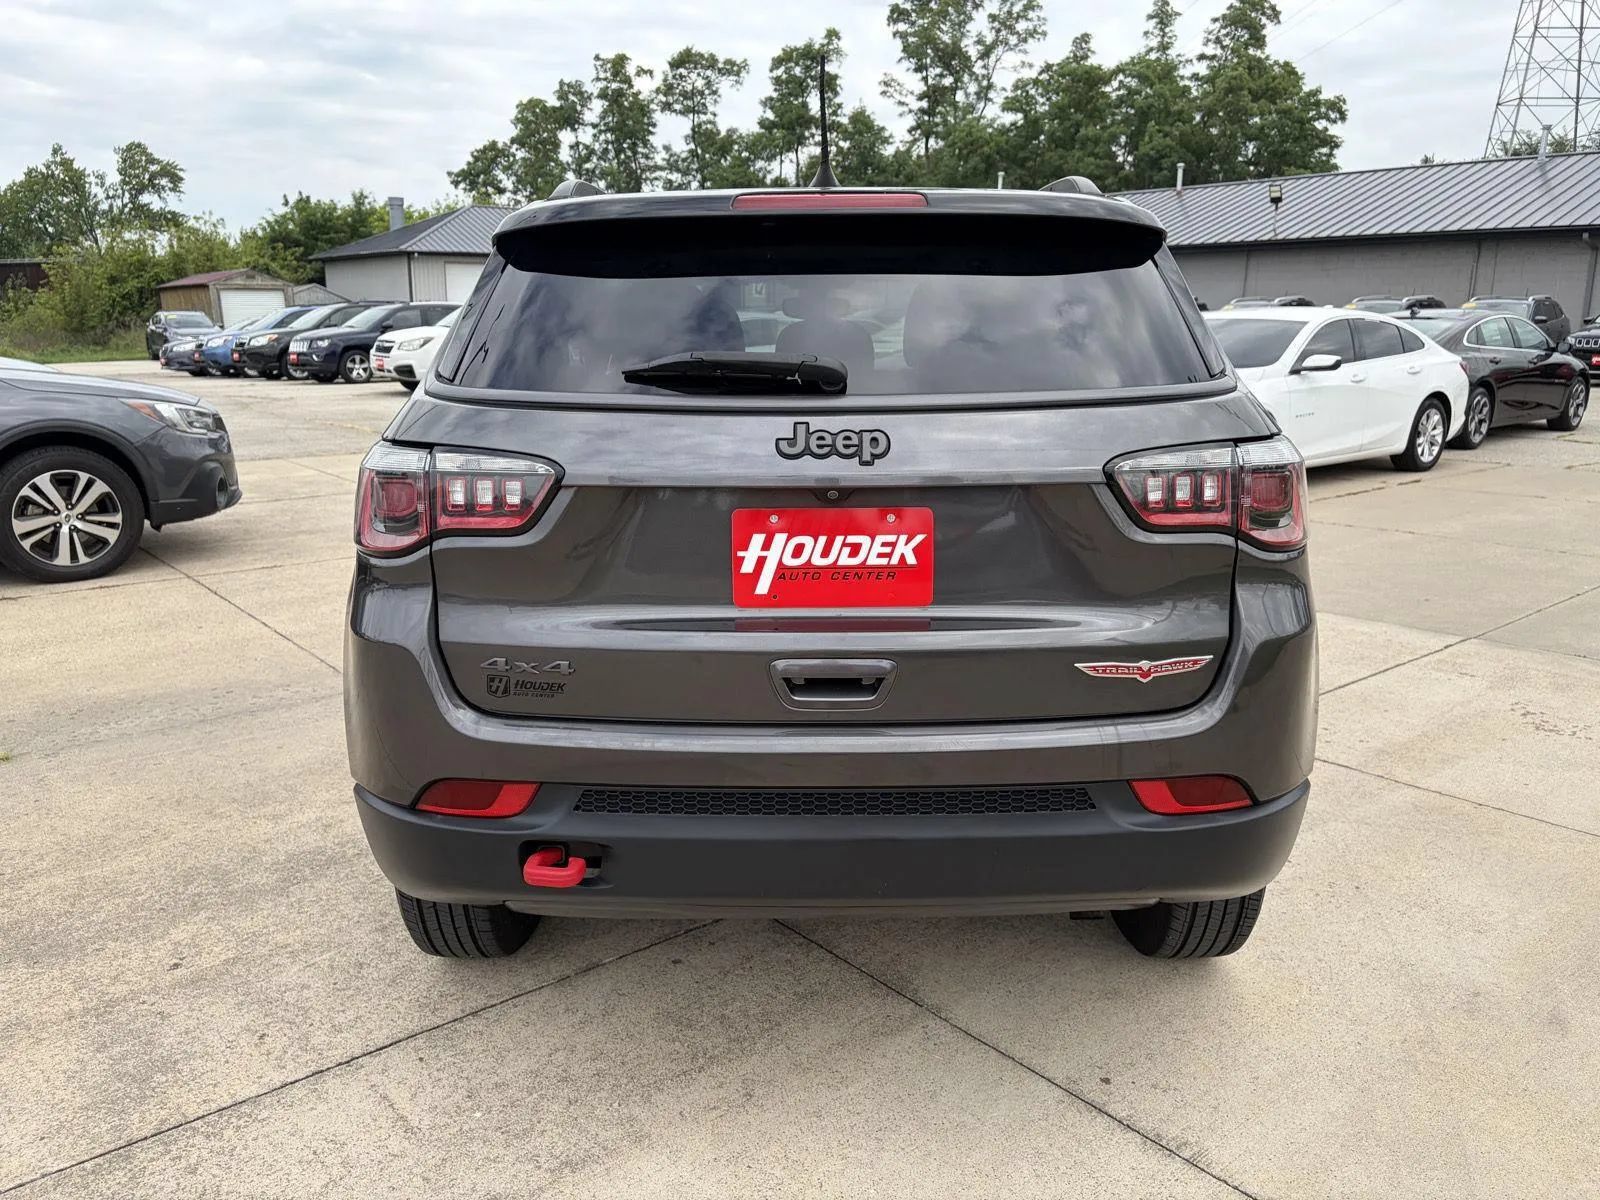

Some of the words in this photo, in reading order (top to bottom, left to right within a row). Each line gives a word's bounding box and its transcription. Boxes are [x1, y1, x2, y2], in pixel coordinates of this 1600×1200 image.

[775, 422, 891, 466] Jeep
[737, 533, 928, 595] HOUDEK
[777, 571, 821, 581] AUTO
[830, 571, 897, 581] CENTER
[1150, 661, 1196, 674] HAWK
[514, 679, 567, 692] HOUDEK
